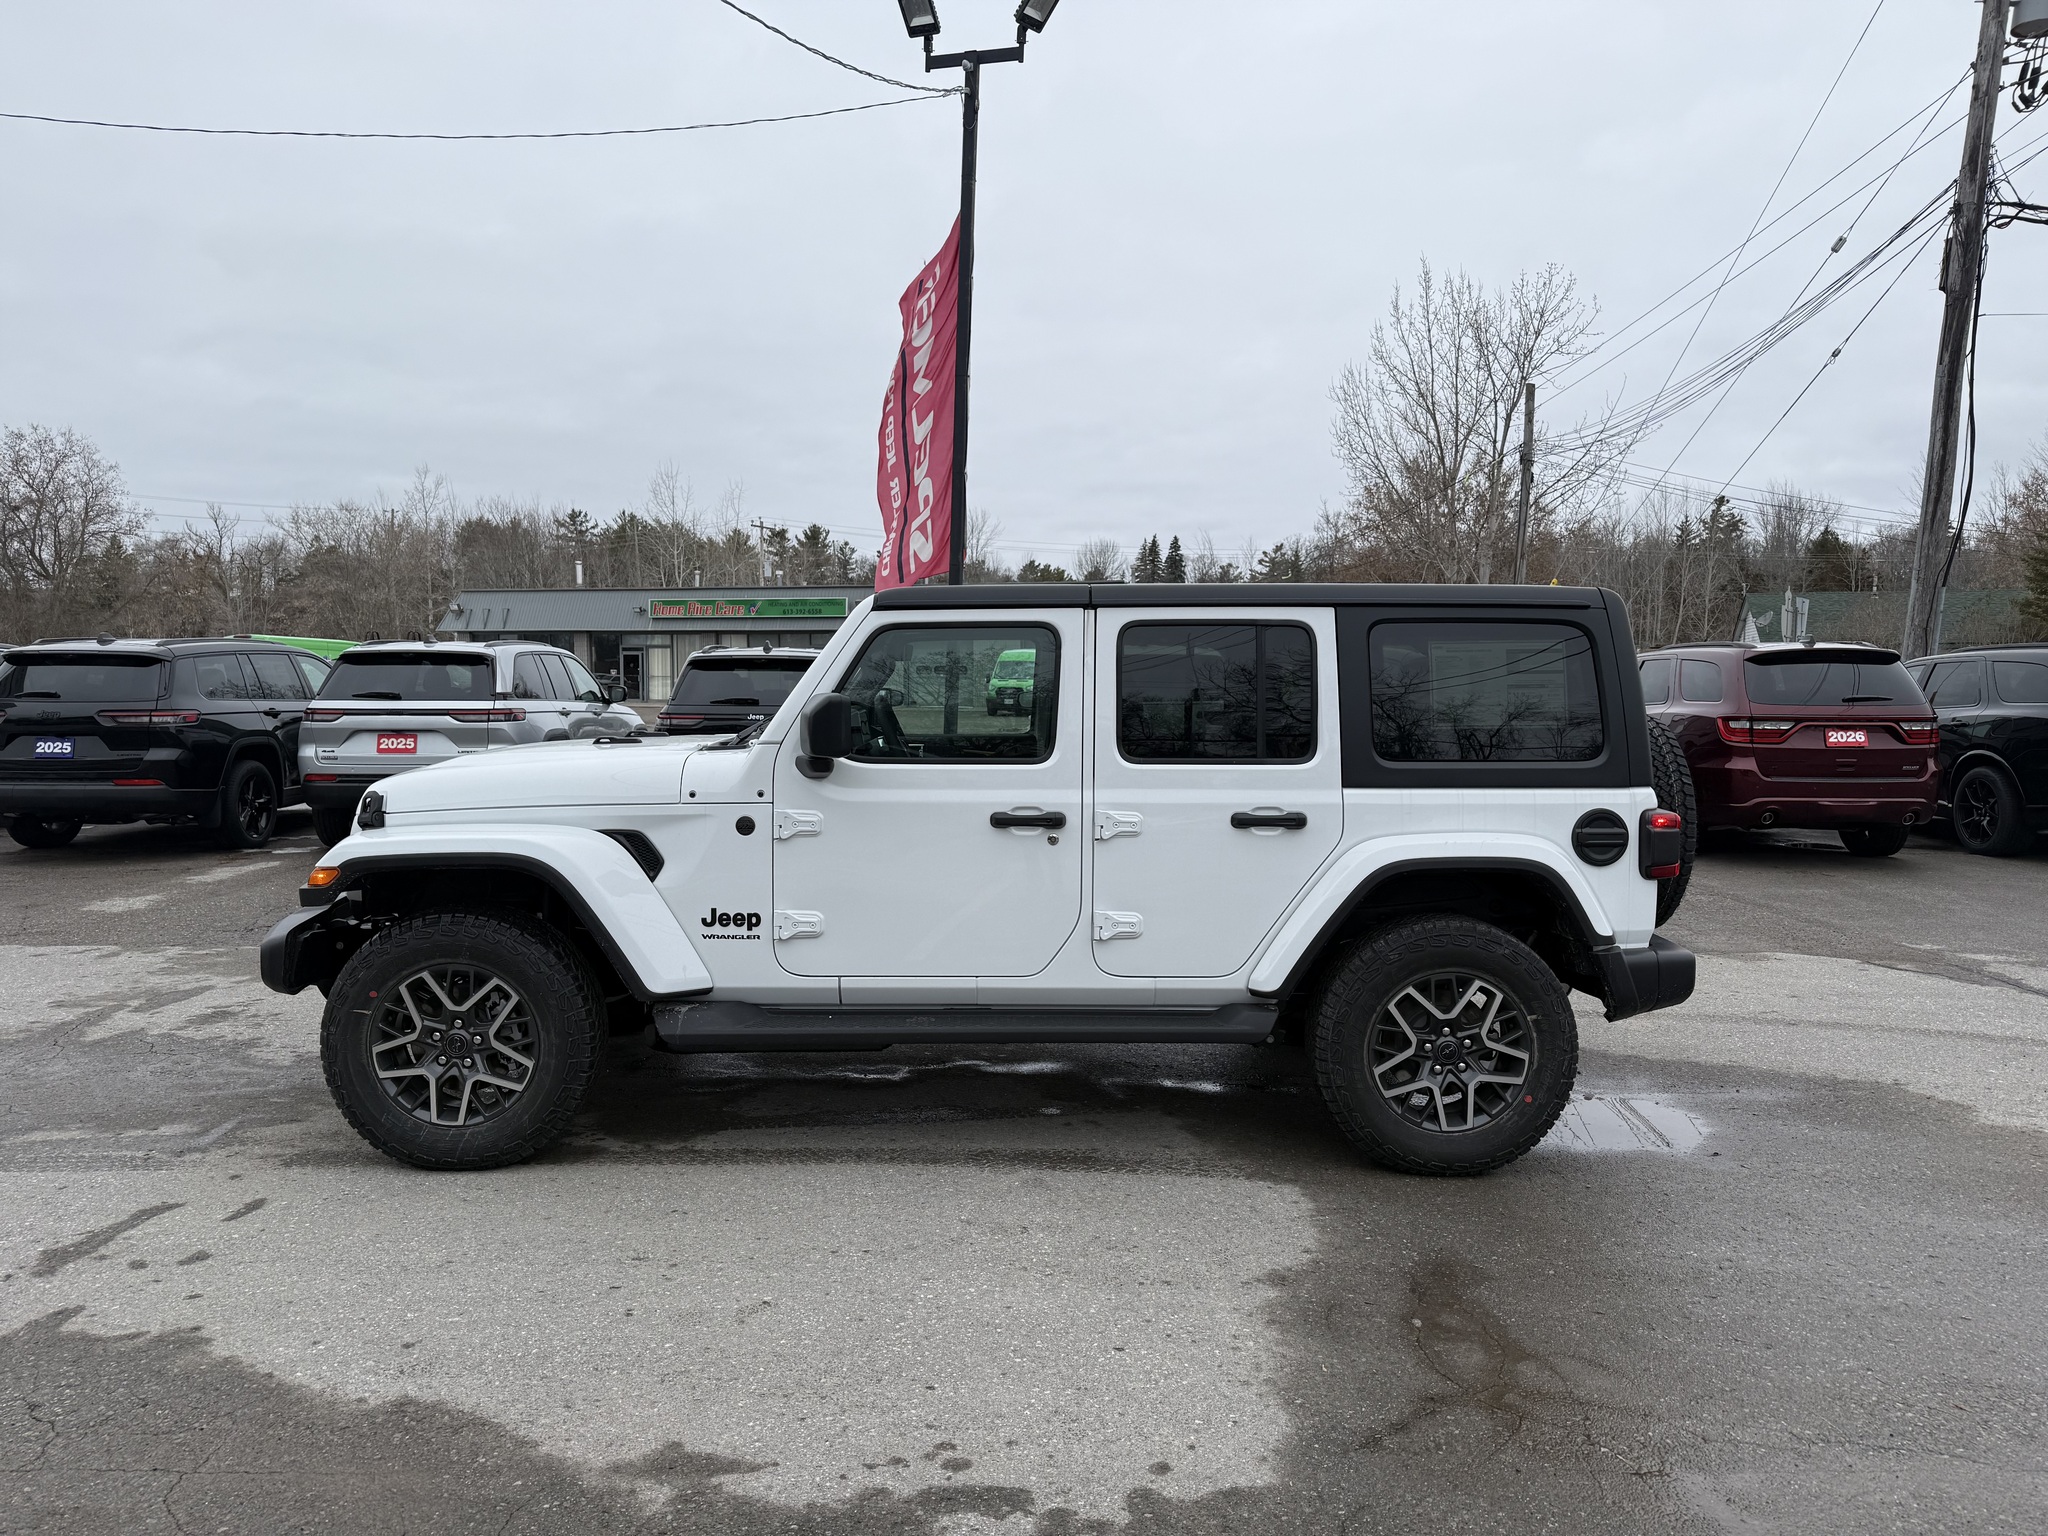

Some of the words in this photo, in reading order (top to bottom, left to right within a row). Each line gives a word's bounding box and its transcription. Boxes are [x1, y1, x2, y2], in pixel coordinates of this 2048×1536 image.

[652, 601, 685, 616] Home
[687, 601, 713, 616] Aire
[715, 601, 745, 616] Care
[1827, 731, 1866, 742] 2026
[35, 742, 72, 753] 2025
[379, 738, 415, 749] 2025
[701, 907, 762, 931] Jeep
